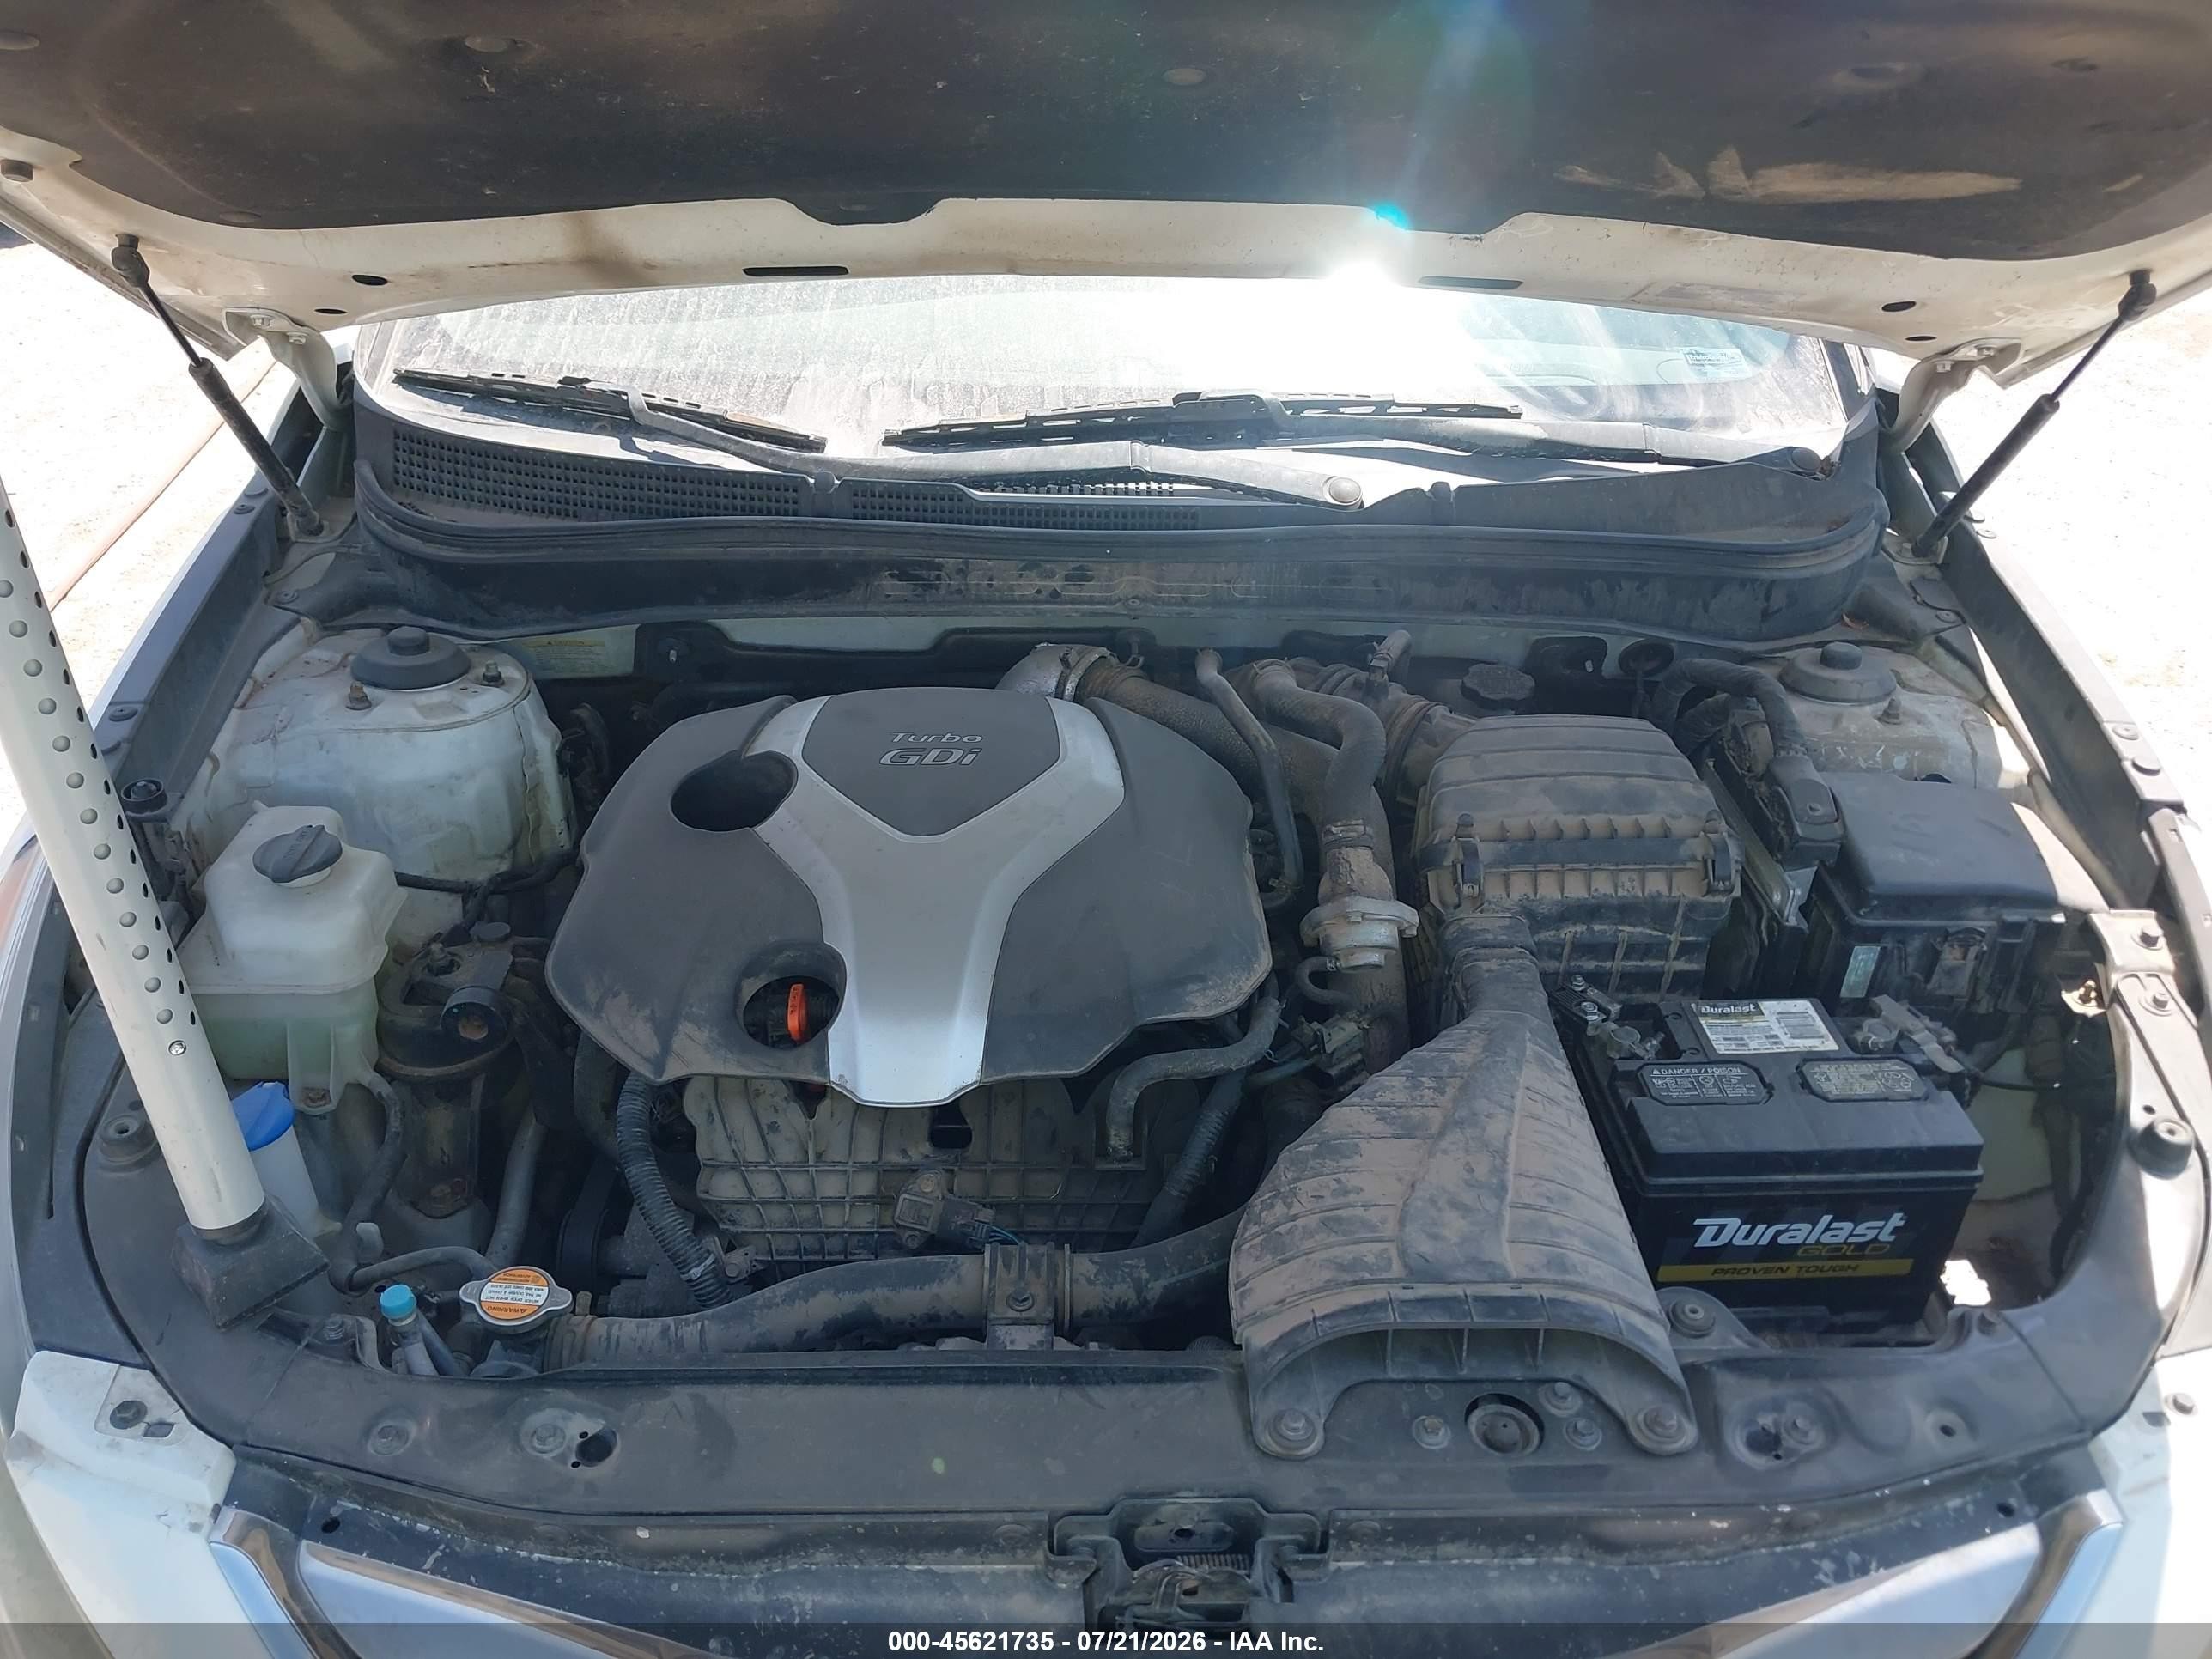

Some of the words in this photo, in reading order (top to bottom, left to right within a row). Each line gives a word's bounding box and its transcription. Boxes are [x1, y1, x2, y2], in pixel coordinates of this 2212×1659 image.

[890, 732, 983, 743] Turbo
[878, 747, 983, 765] GDi
[1701, 1003, 1758, 1014] Duralast
[1692, 1212, 1905, 1248] Duralast
[1797, 1244, 1889, 1255] GOLD
[1711, 1266, 1790, 1277] PROVEN
[1796, 1264, 1860, 1273] TOUGH
